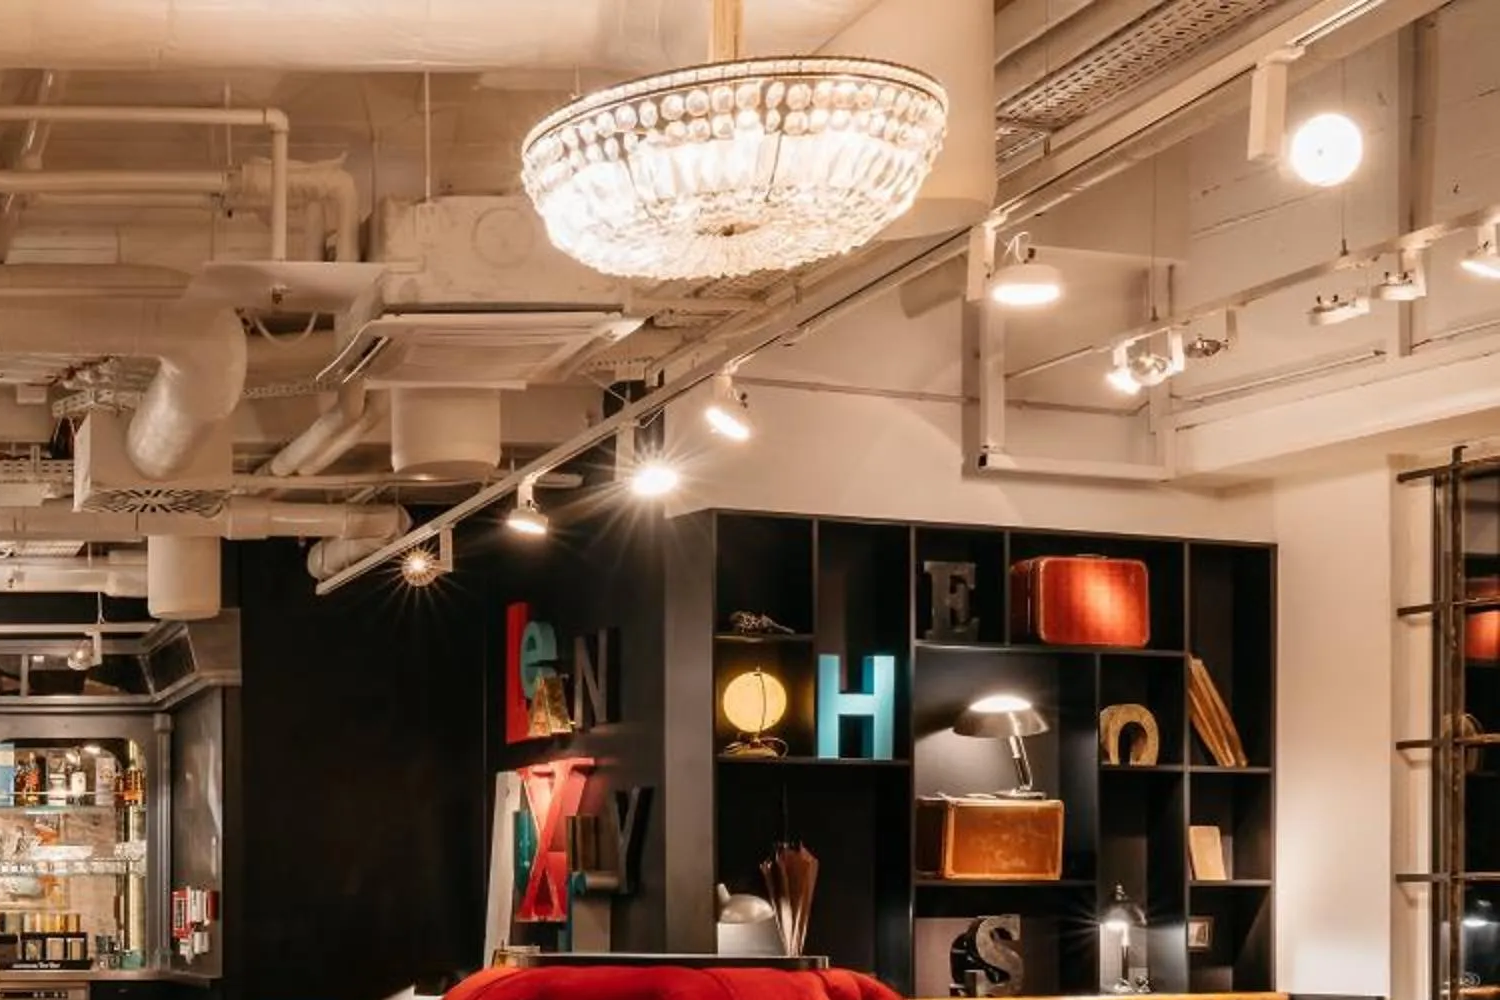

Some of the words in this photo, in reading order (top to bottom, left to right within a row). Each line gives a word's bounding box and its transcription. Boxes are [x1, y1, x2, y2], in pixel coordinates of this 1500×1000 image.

[924, 561, 980, 642] E
[574, 627, 612, 729] N
[818, 653, 895, 760] H
[970, 914, 1025, 998] S
